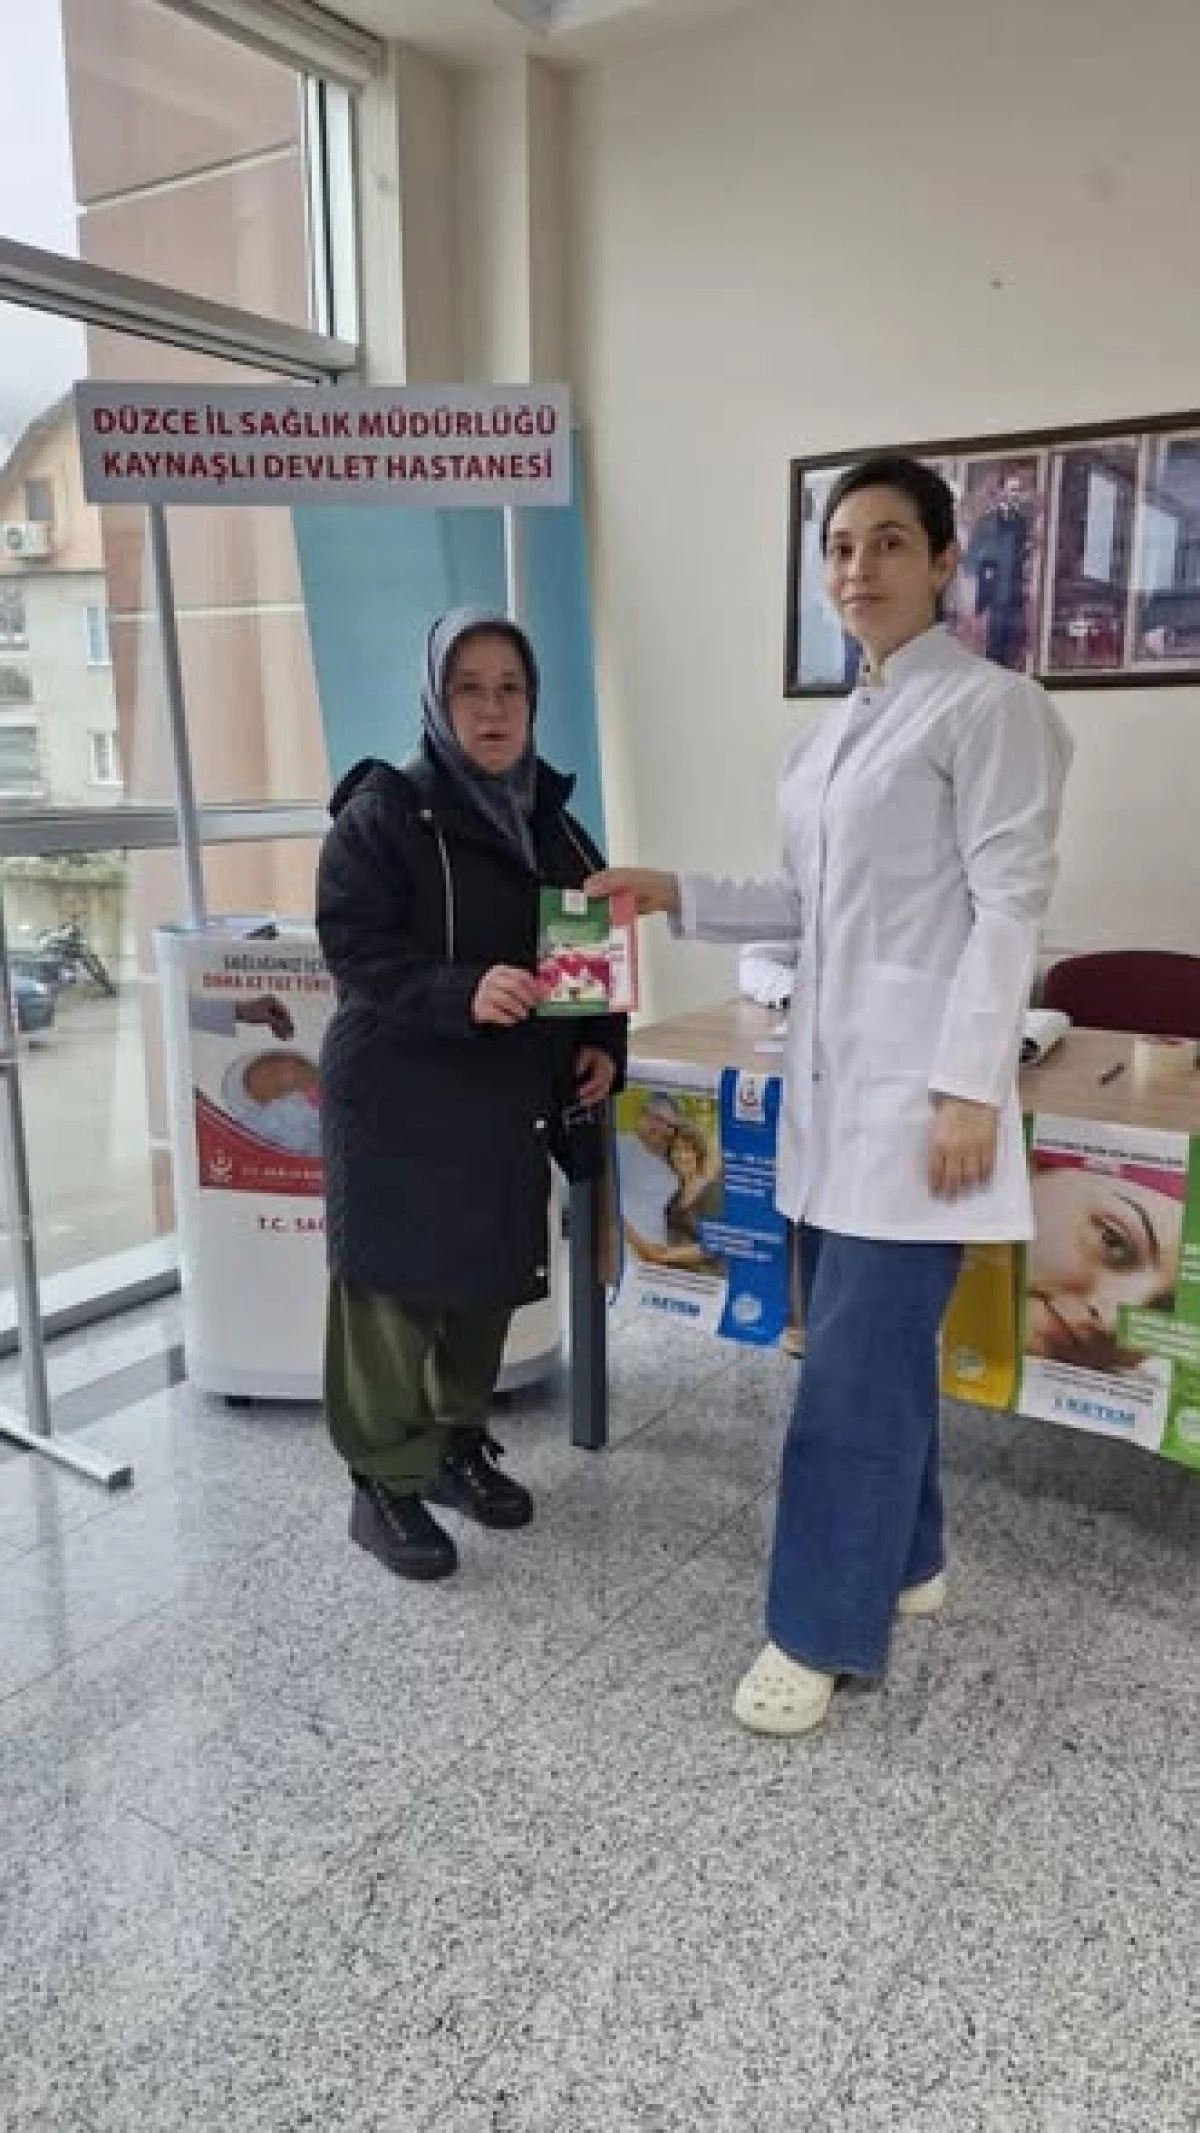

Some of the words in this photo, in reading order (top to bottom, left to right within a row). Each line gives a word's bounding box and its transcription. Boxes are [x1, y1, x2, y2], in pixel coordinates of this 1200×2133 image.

[93, 406, 200, 436] DÜZCE
[205, 405, 233, 436] İL
[240, 405, 351, 438] SAĞLIK
[358, 404, 557, 438] MÜDÜRLÜĞÜ
[103, 450, 257, 485] KAYNAŞLI
[263, 455, 379, 480] DEVLET
[387, 448, 553, 481] HASTANESİ
